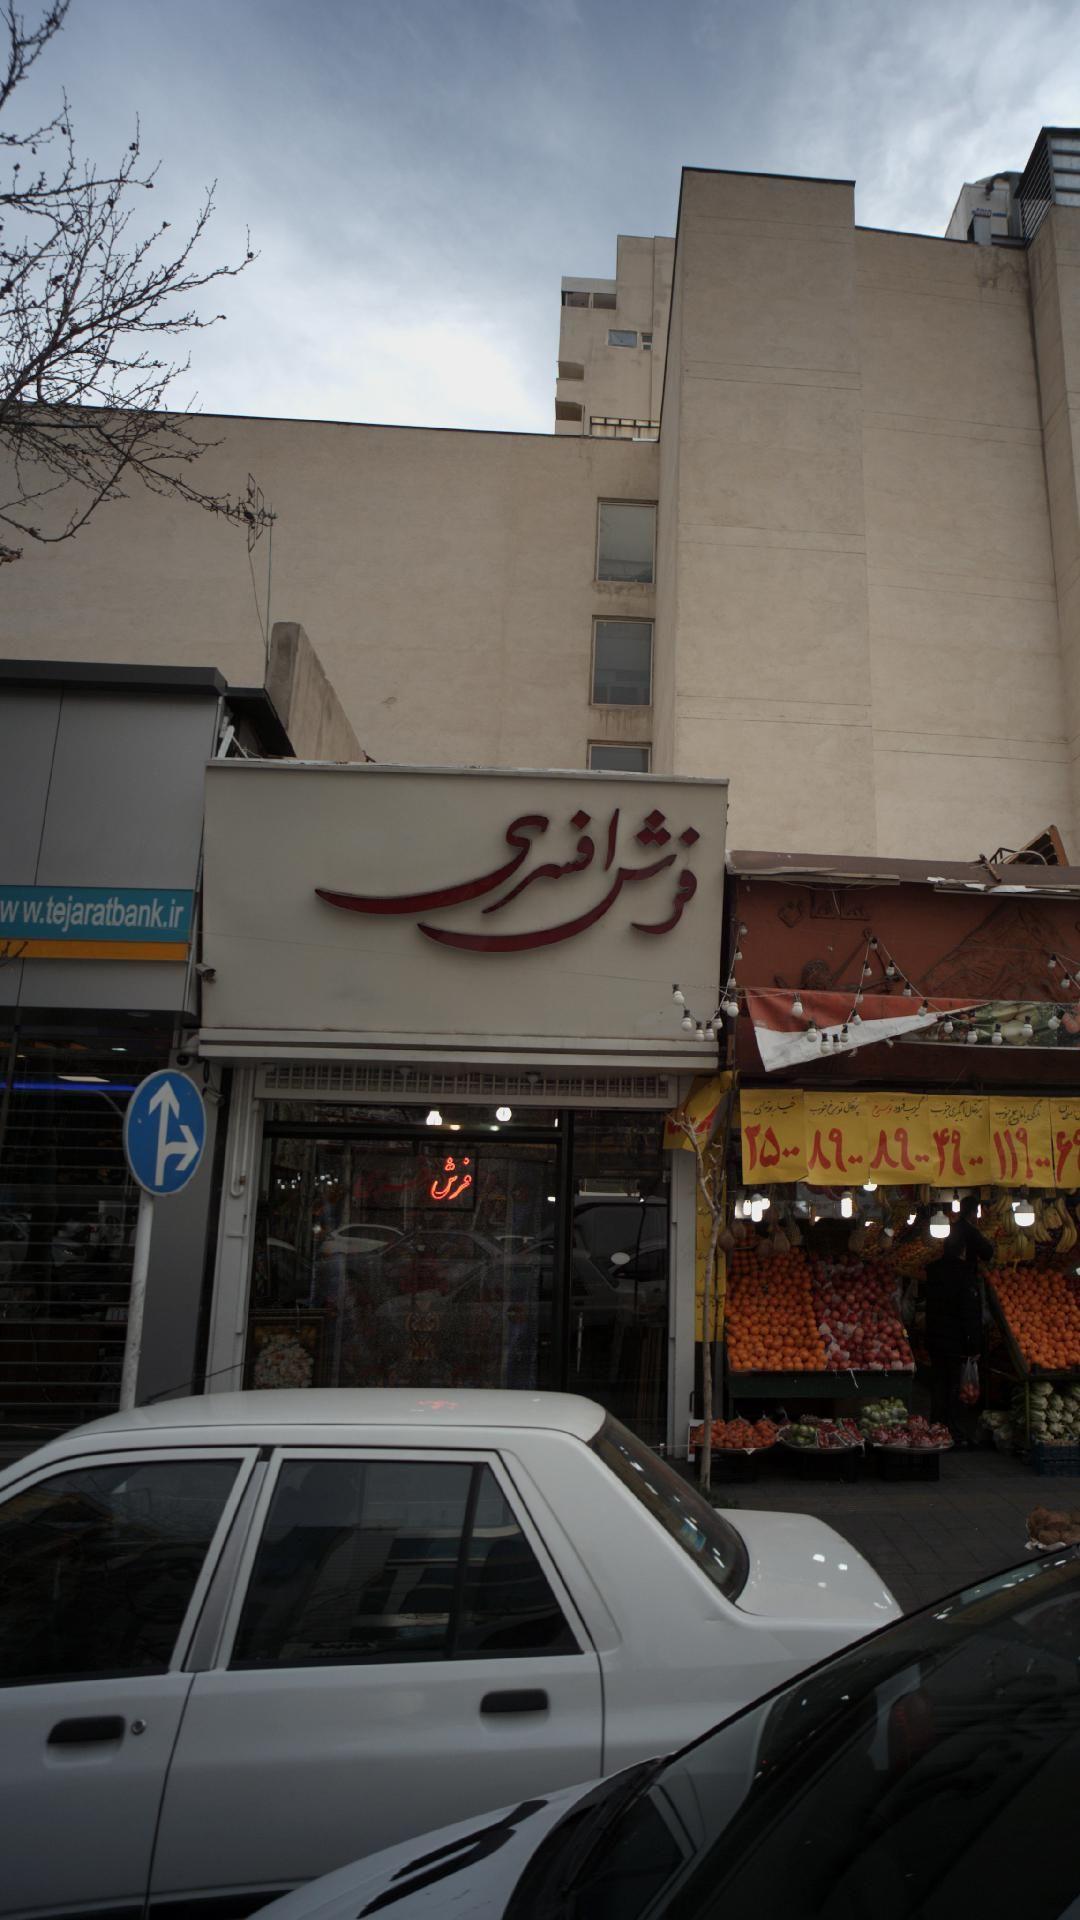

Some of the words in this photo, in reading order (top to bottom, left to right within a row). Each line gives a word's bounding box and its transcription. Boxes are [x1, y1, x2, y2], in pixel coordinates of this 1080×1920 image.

[416, 808, 701, 954] فرش
[808, 1127, 864, 1173] ۸۹۰۰
[870, 1127, 930, 1171] ۸۹۰۰
[932, 1127, 984, 1177] ۴۹۰۰
[993, 1127, 1051, 1180] ۱۱۹۰۰
[428, 1156, 473, 1200] فرش
